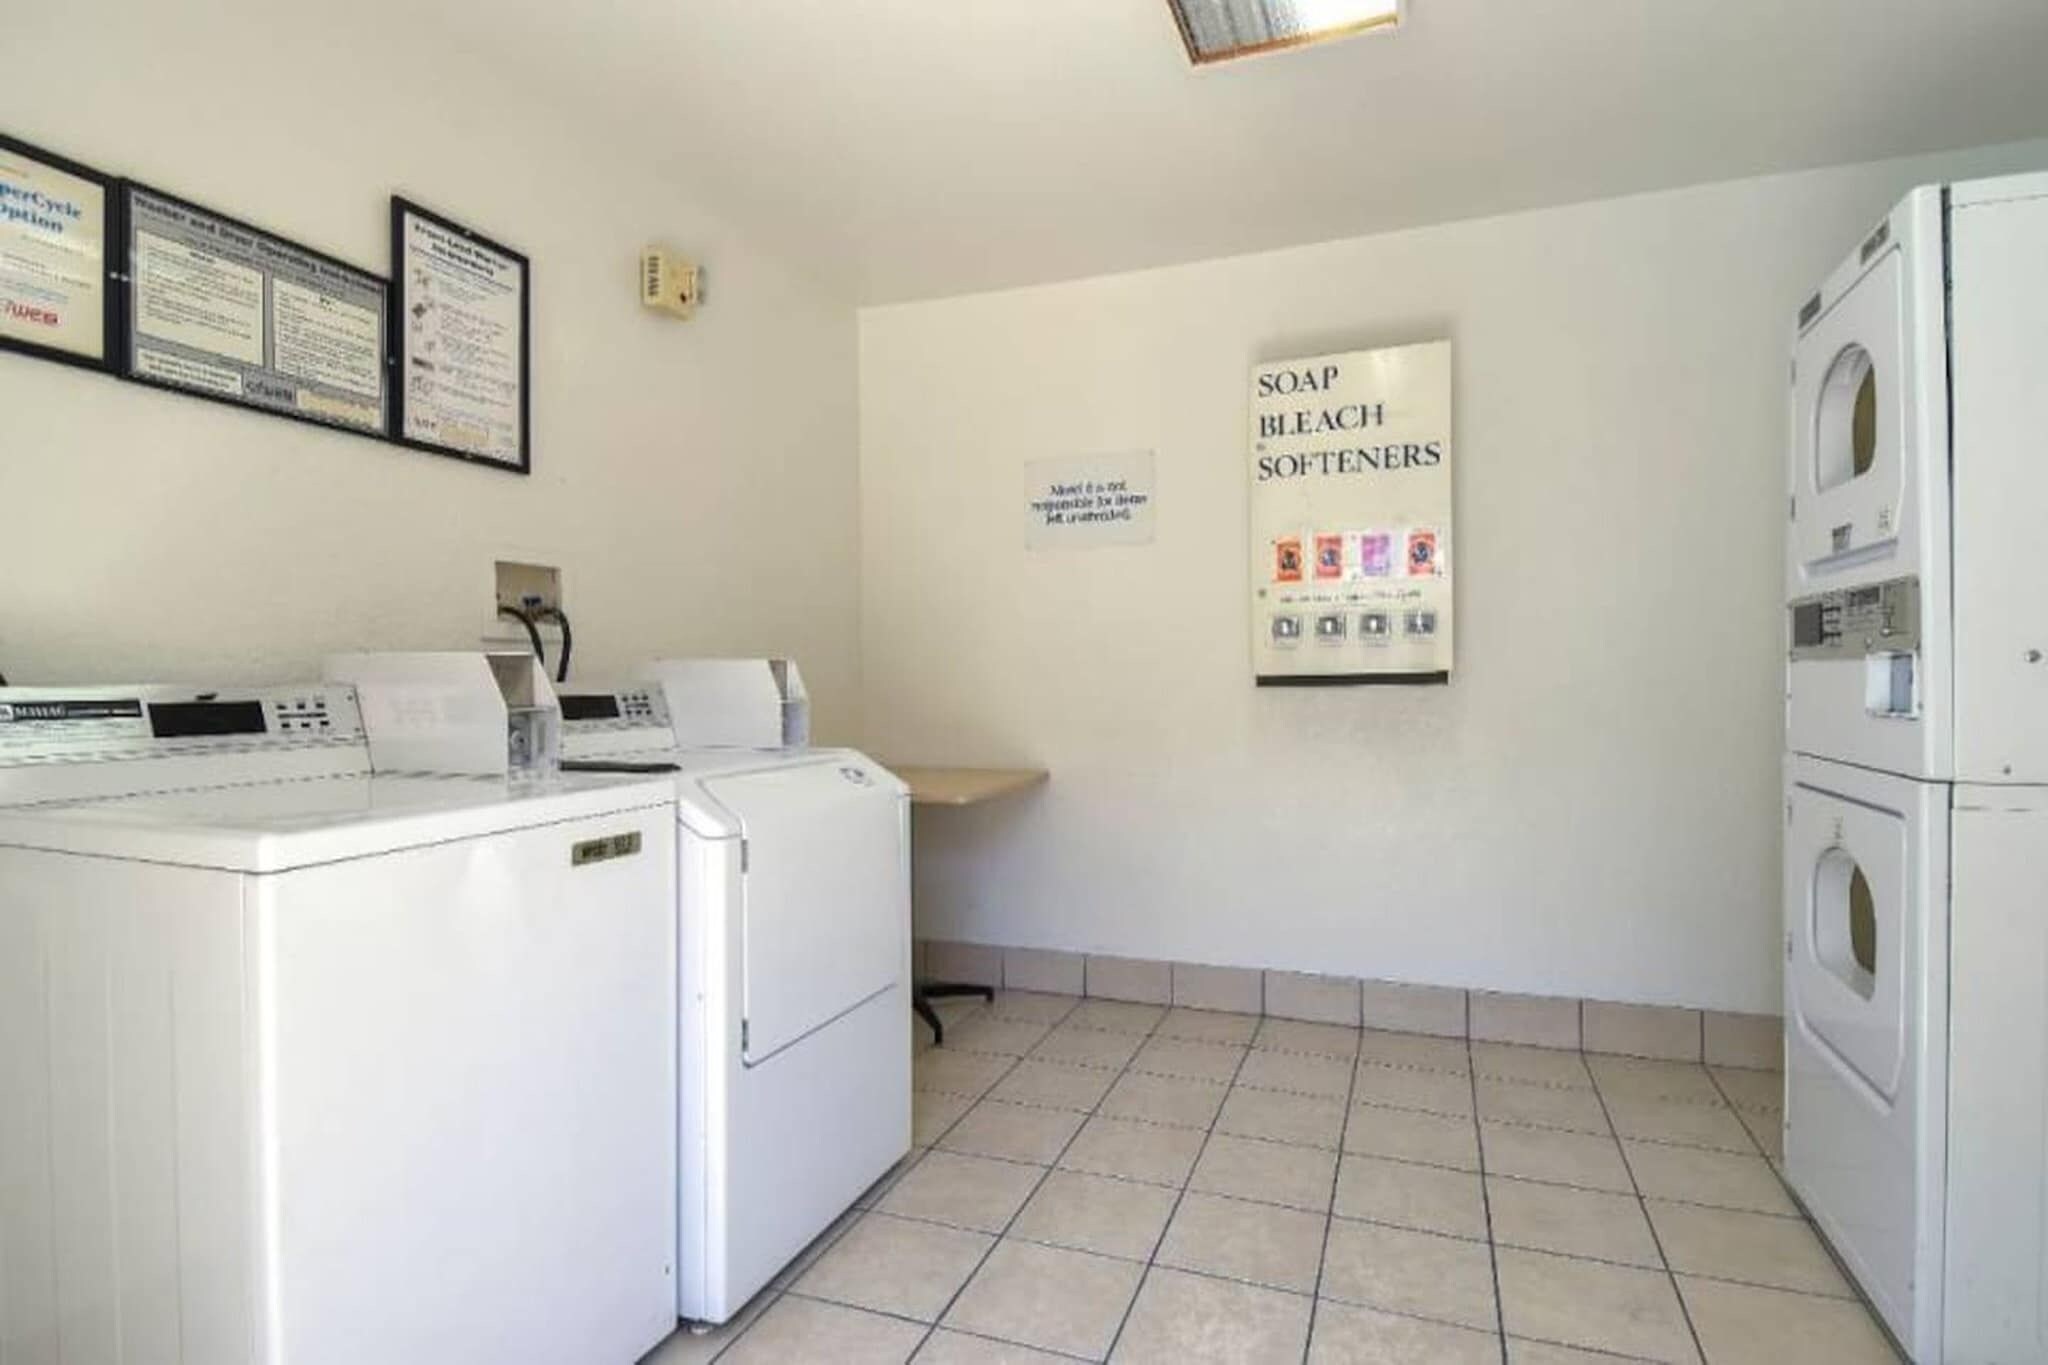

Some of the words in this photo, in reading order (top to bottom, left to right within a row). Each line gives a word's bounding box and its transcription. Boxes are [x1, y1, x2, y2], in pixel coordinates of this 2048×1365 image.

[1258, 365, 1338, 398] SOAP
[1260, 402, 1385, 438] BLEACH
[1258, 440, 1441, 482] SOFTENERS
